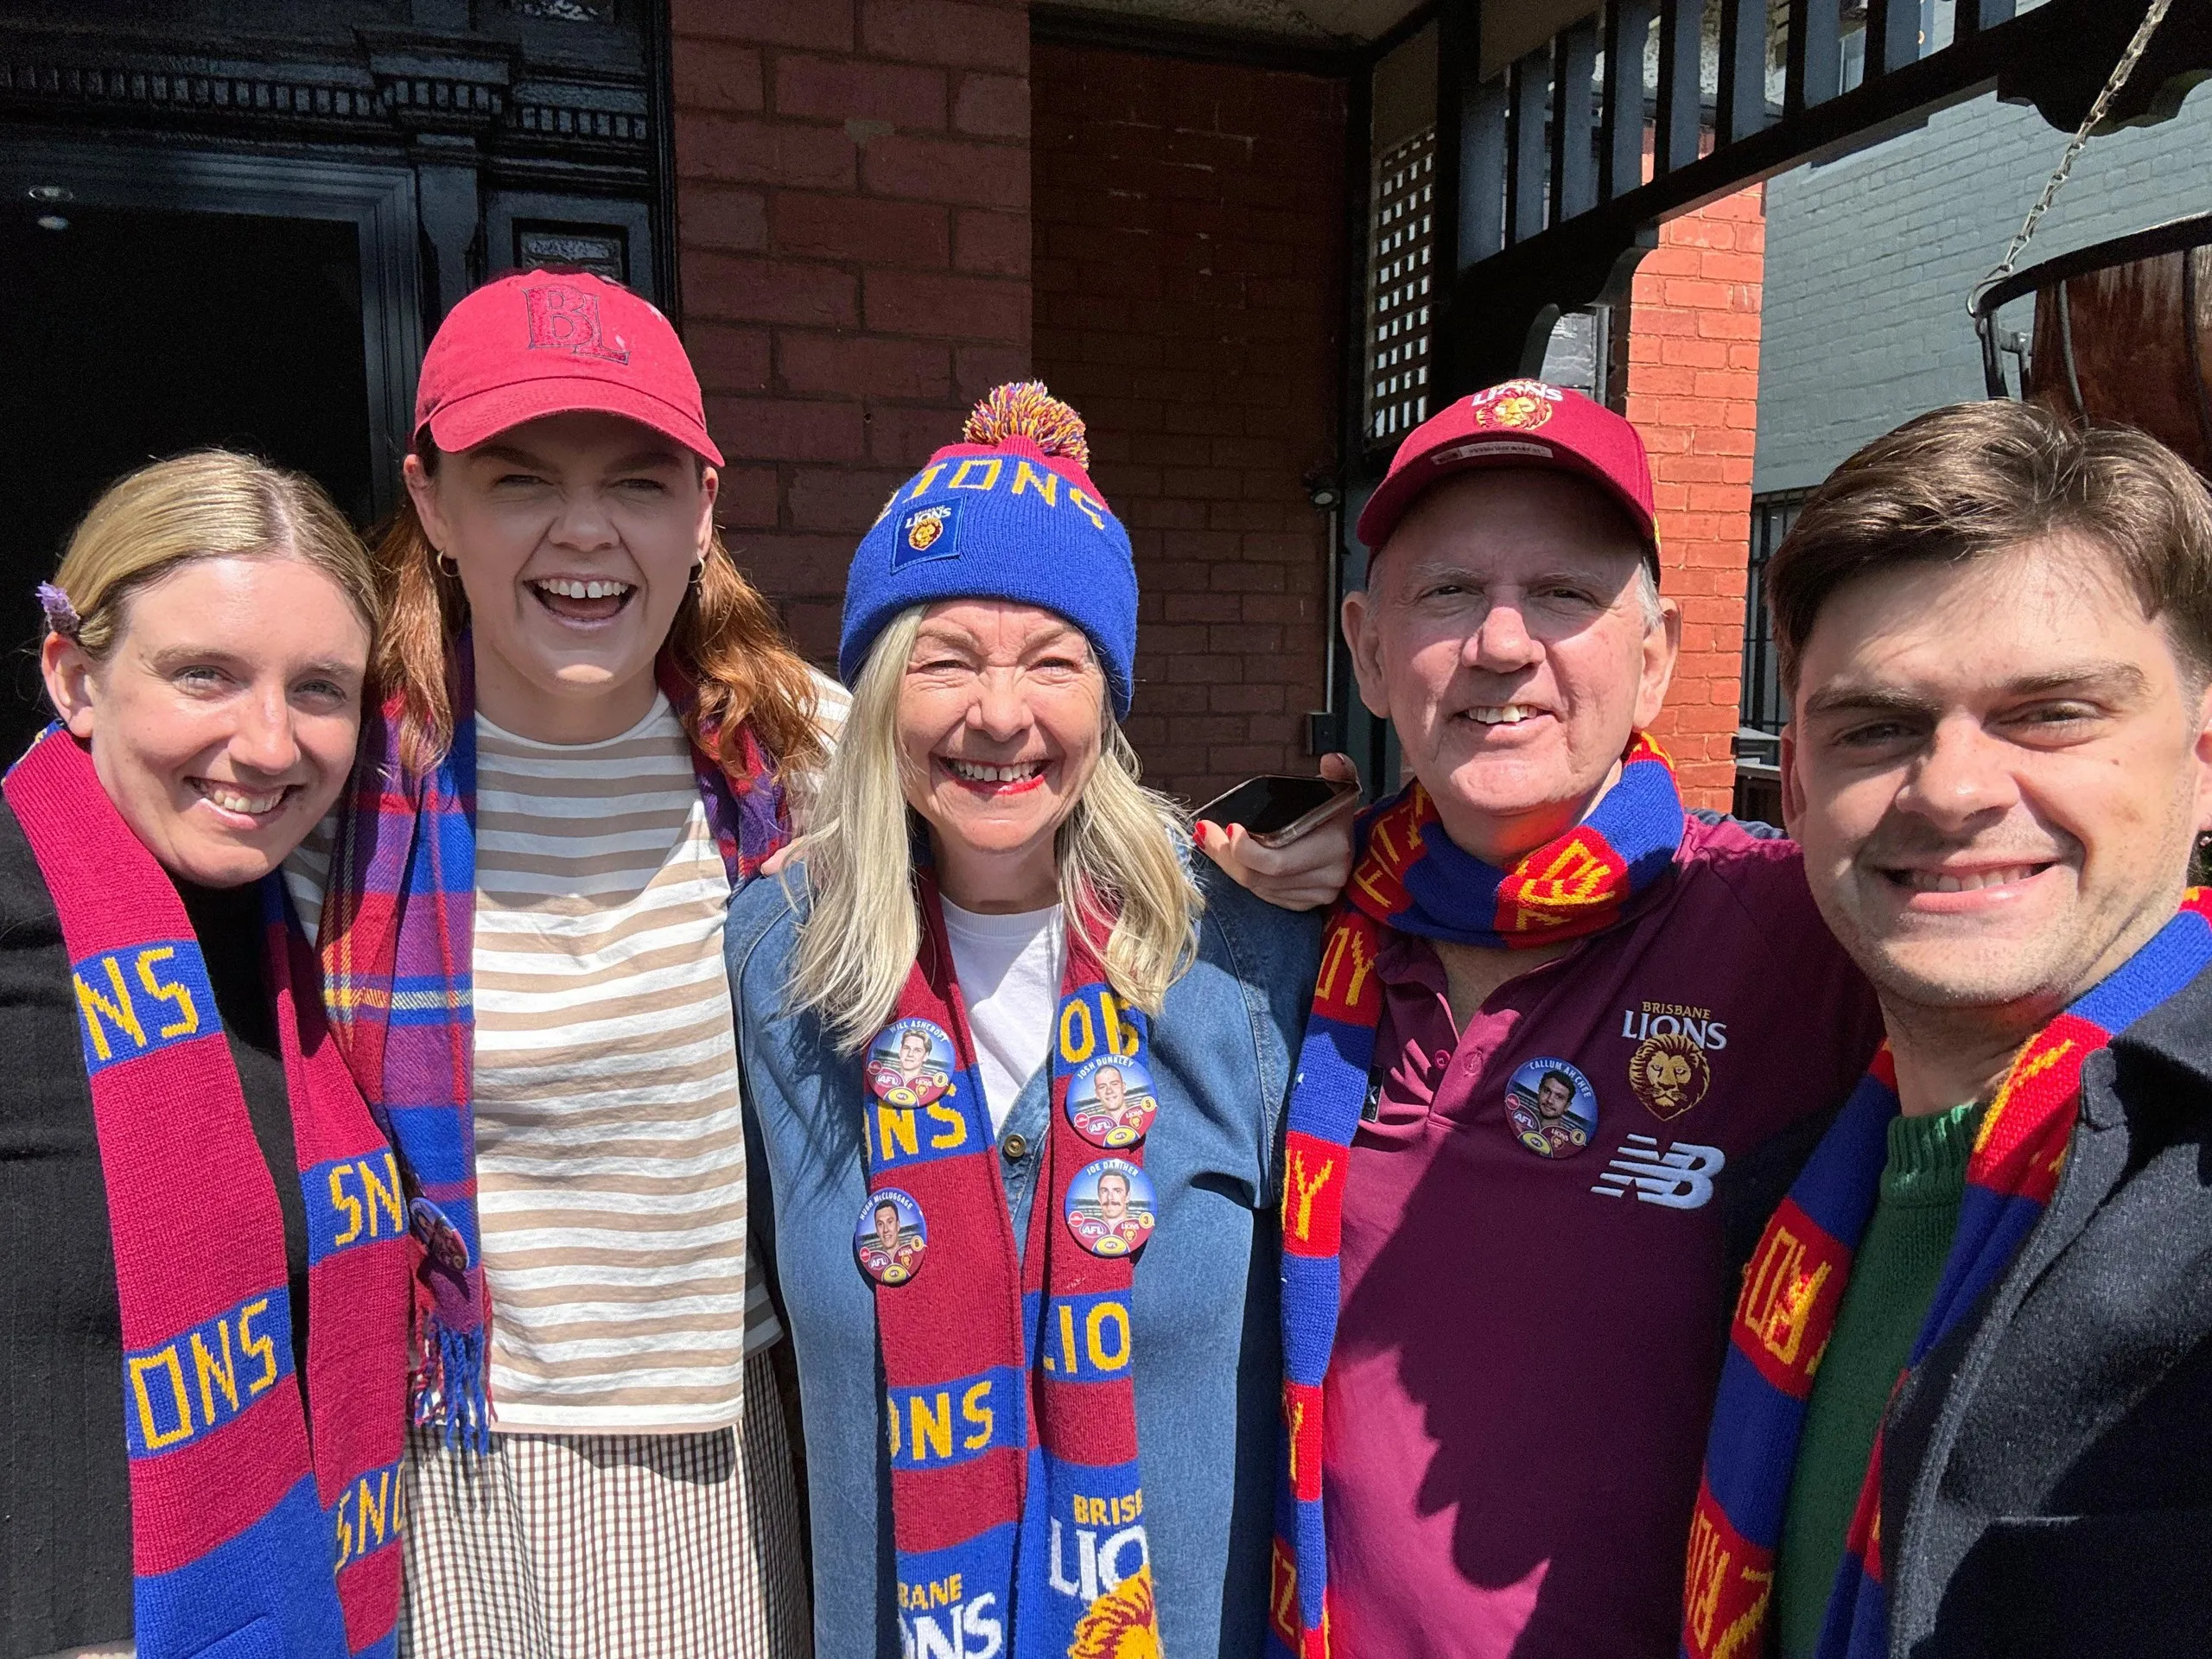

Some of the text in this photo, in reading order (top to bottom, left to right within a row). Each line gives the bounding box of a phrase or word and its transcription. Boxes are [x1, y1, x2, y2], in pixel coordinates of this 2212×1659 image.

[522, 283, 631, 365] BL
[905, 507, 952, 529] LIONS
[1642, 1001, 1711, 1020] BRISBANE
[889, 1020, 950, 1043] WILL ASHCROFT
[1622, 1009, 1726, 1051] LIONS
[1077, 1056, 1135, 1080] JOSH DUNKLEY
[1529, 1059, 1592, 1098] CALLUM AH CHEE
[878, 1075, 899, 1086] AFL
[938, 1075, 944, 1084] 8
[1145, 1099, 1152, 1109] 5
[863, 1082, 968, 1160] NS
[1090, 1121, 1111, 1133] AFL
[1513, 1112, 1535, 1128] AFL
[1551, 1128, 1570, 1141] LIONS
[1086, 1159, 1139, 1177] JOE DANIHER
[859, 1199, 874, 1221] HUGH
[1143, 1216, 1149, 1225] 3
[1082, 1225, 1104, 1235] AFL
[871, 1257, 887, 1268] AFL
[1043, 1301, 1131, 1374] IO
[129, 1299, 277, 1450] ONS
[887, 1381, 993, 1460] NS
[897, 1592, 1002, 1659] NS
